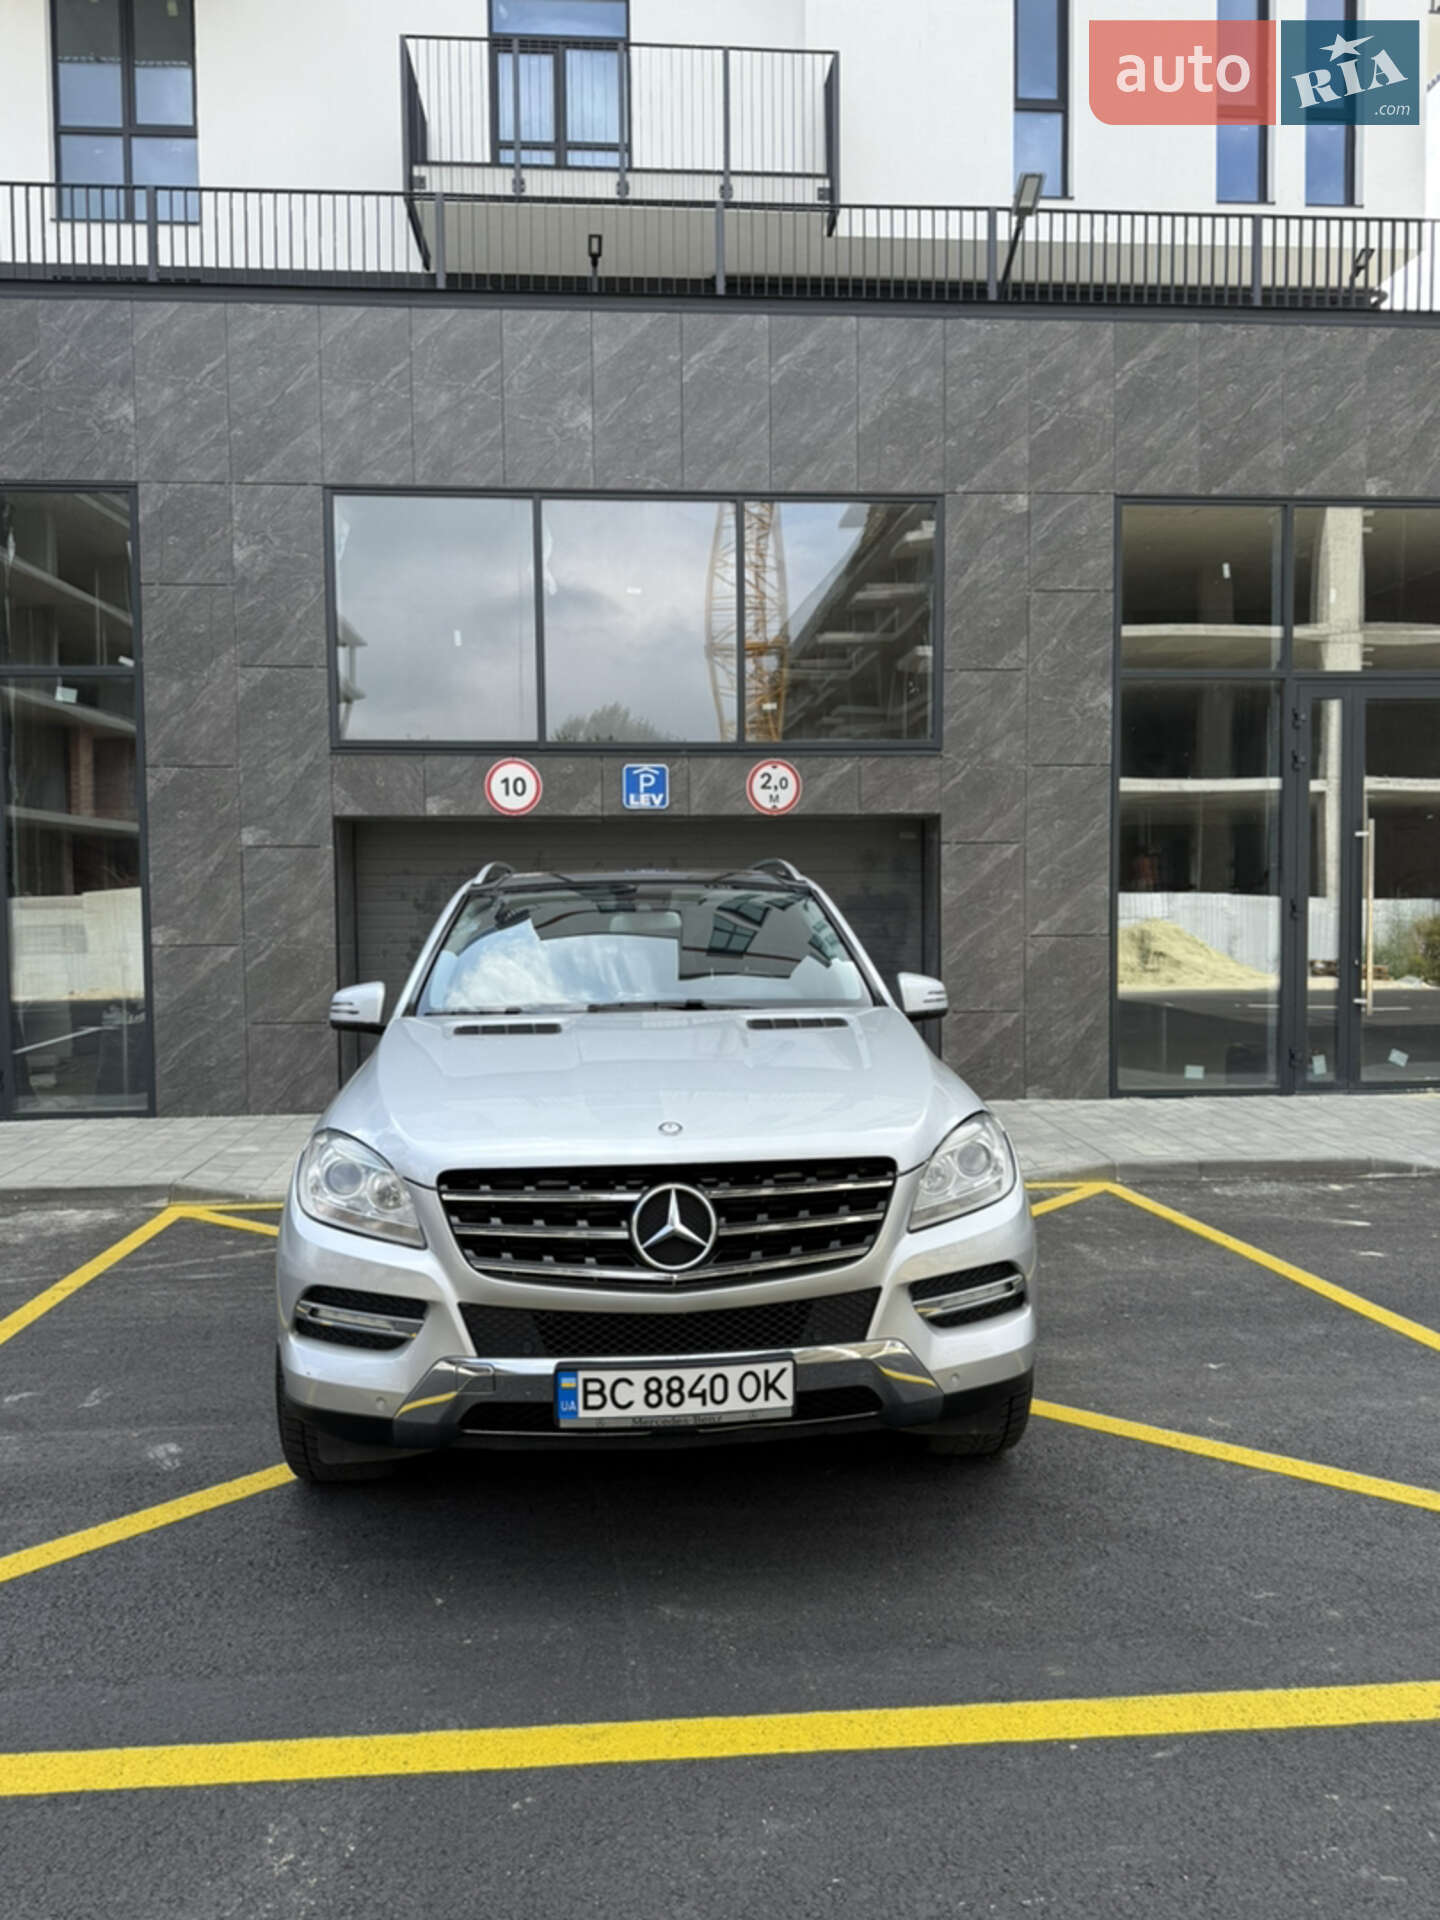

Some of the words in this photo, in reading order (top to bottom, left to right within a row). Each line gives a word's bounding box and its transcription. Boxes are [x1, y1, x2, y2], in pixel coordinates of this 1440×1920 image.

[499, 776, 527, 797] 10
[639, 773, 656, 793] P
[760, 772, 789, 792] 2,0
[629, 793, 664, 807] LEV
[582, 1377, 635, 1411] BC
[643, 1373, 729, 1409] 8840
[738, 1367, 788, 1403] OK
[560, 1401, 577, 1412] UA
